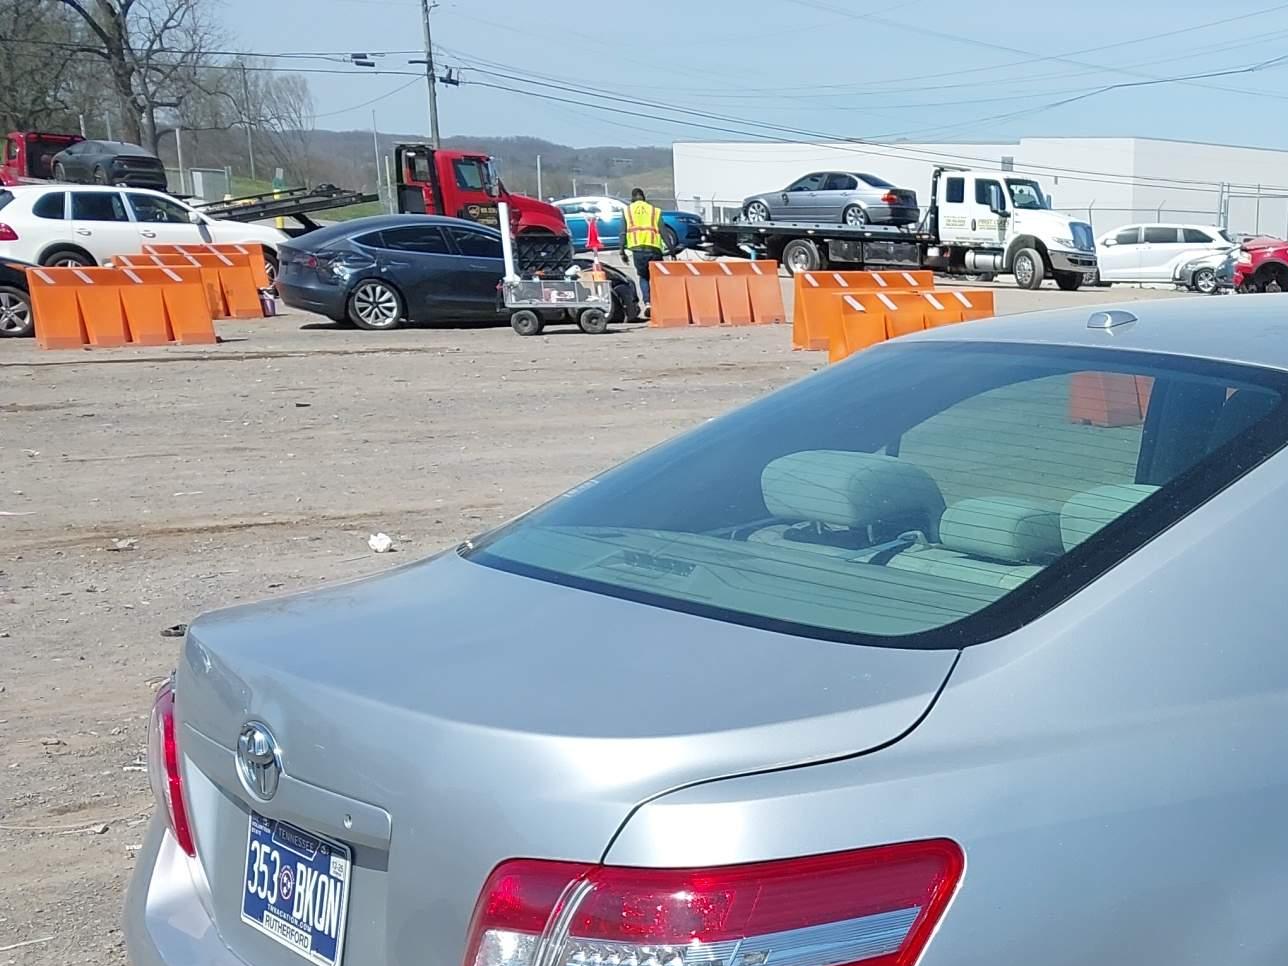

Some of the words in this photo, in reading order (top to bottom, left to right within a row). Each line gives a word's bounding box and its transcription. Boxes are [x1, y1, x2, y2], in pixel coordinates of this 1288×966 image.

[278, 828, 315, 852] TENNESSEE
[247, 840, 281, 905] 353
[292, 861, 342, 939] BKQN
[264, 914, 309, 949] RUTHERFORD
